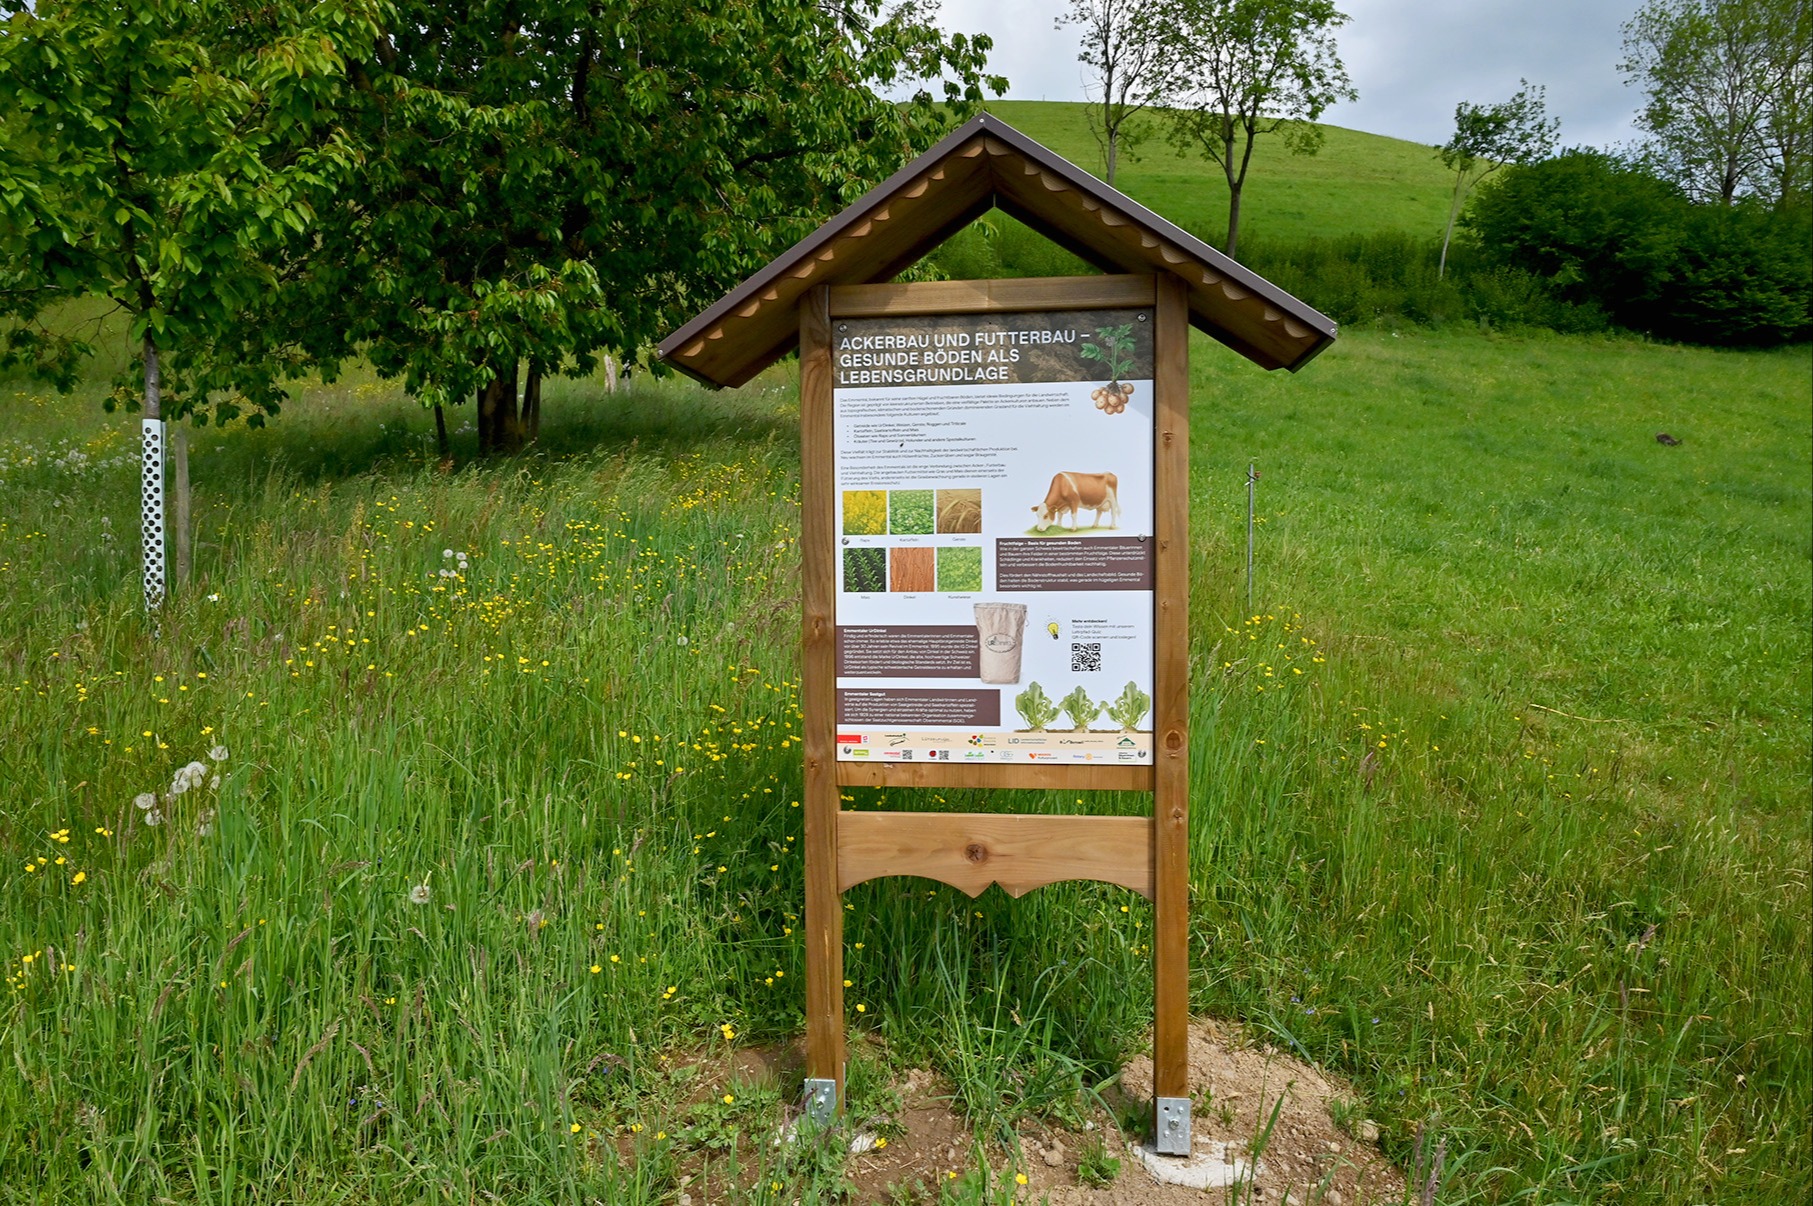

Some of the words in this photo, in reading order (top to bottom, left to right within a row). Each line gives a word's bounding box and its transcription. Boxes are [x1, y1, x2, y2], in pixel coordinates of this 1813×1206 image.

[840, 334, 930, 350] ACKERBAU
[934, 332, 970, 347] UND
[975, 329, 1076, 346] FUTTERBAU
[840, 352, 919, 367] GESUNDE
[923, 348, 983, 365] BÖDEN
[987, 348, 1020, 363] ALS
[840, 366, 1009, 384] LEBENSGRUNDLAGE
